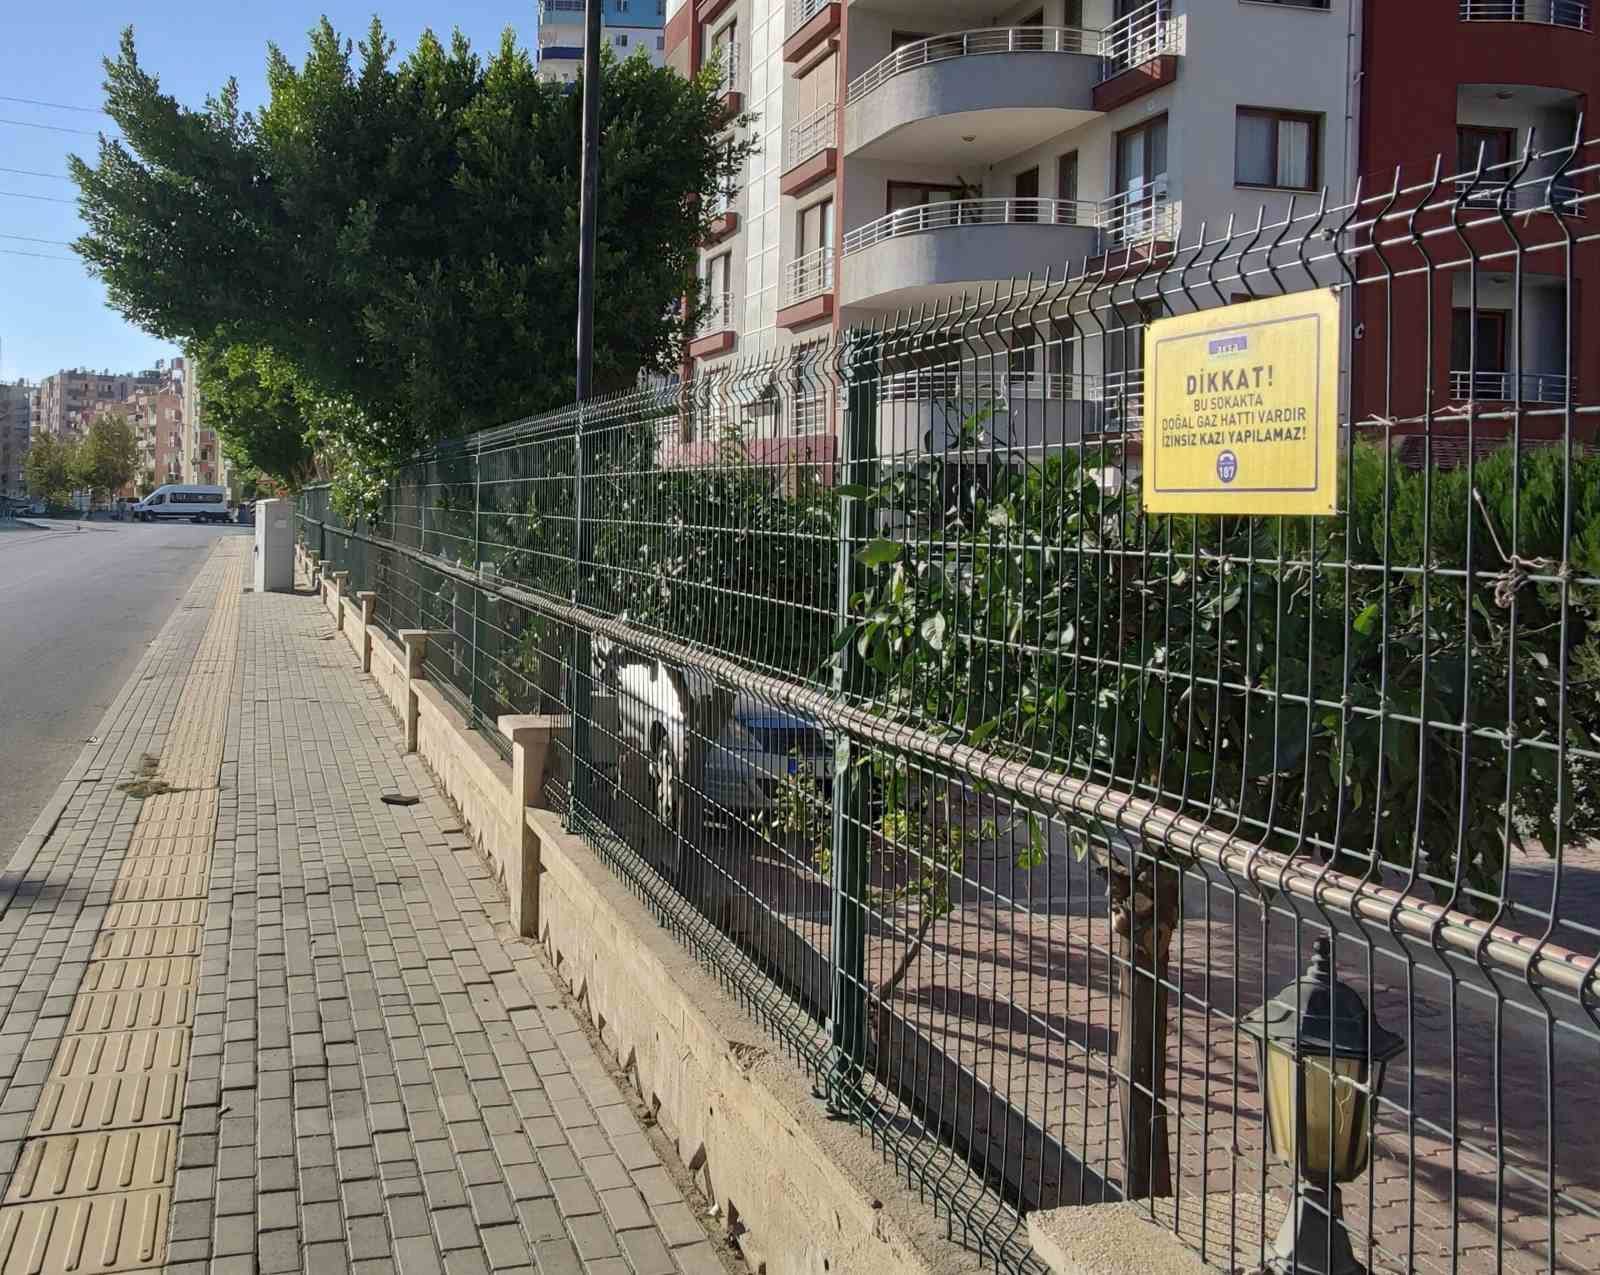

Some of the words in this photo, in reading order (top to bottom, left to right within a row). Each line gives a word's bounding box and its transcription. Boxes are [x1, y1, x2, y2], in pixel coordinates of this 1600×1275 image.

[1187, 365, 1273, 395] DİKKAT!
[1193, 399, 1208, 412] BU
[1210, 394, 1263, 410] SOKAKTA
[1162, 414, 1194, 431] DOĞAL
[1197, 414, 1217, 428] GAZ
[1220, 411, 1255, 427] HATTI
[1258, 407, 1306, 423] VARDIR
[1199, 431, 1225, 445] KAZI
[1228, 427, 1306, 444] YAPILAMAZ!
[1219, 465, 1234, 478] 187
